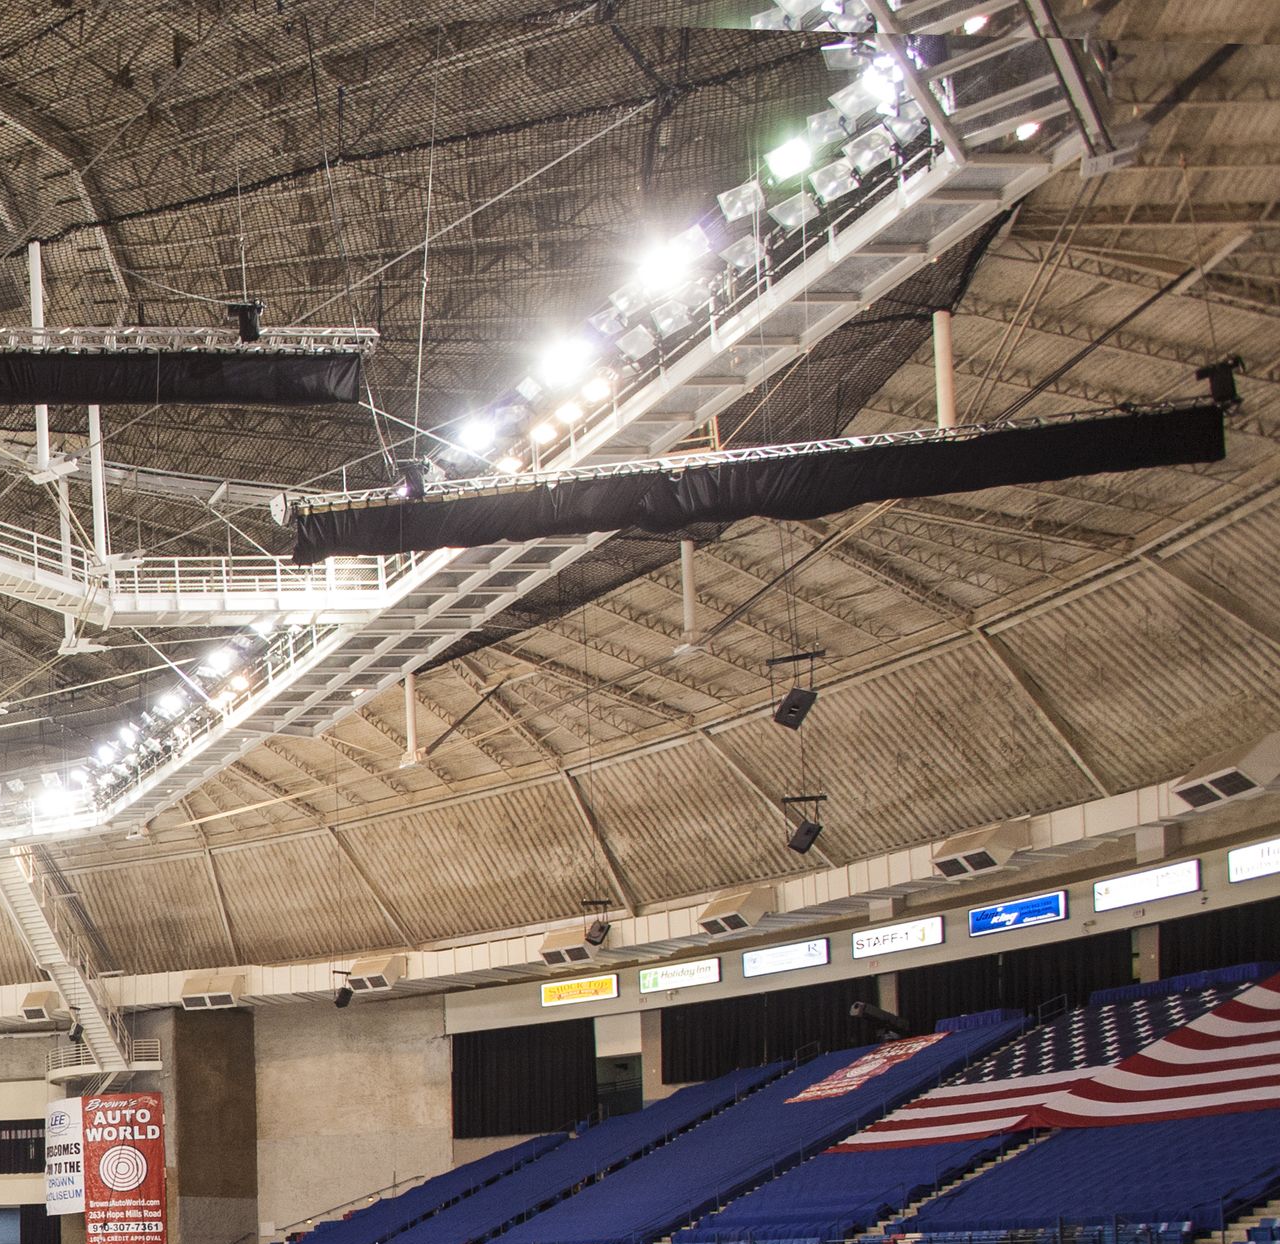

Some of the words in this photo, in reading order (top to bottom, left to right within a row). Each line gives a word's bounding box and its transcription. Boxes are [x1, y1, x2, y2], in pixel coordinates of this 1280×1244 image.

[856, 932, 909, 950] STAFF-1
[661, 967, 696, 979] Holiday
[696, 965, 711, 973] Inn
[86, 1098, 137, 1112] Brown's
[51, 1114, 66, 1126] LEE
[94, 1109, 151, 1125] AUTO
[85, 1125, 160, 1142] WORLD
[64, 1161, 81, 1174] THE
[107, 1210, 125, 1220] Hope
[126, 1209, 142, 1218] Mills
[144, 1209, 161, 1218] Road
